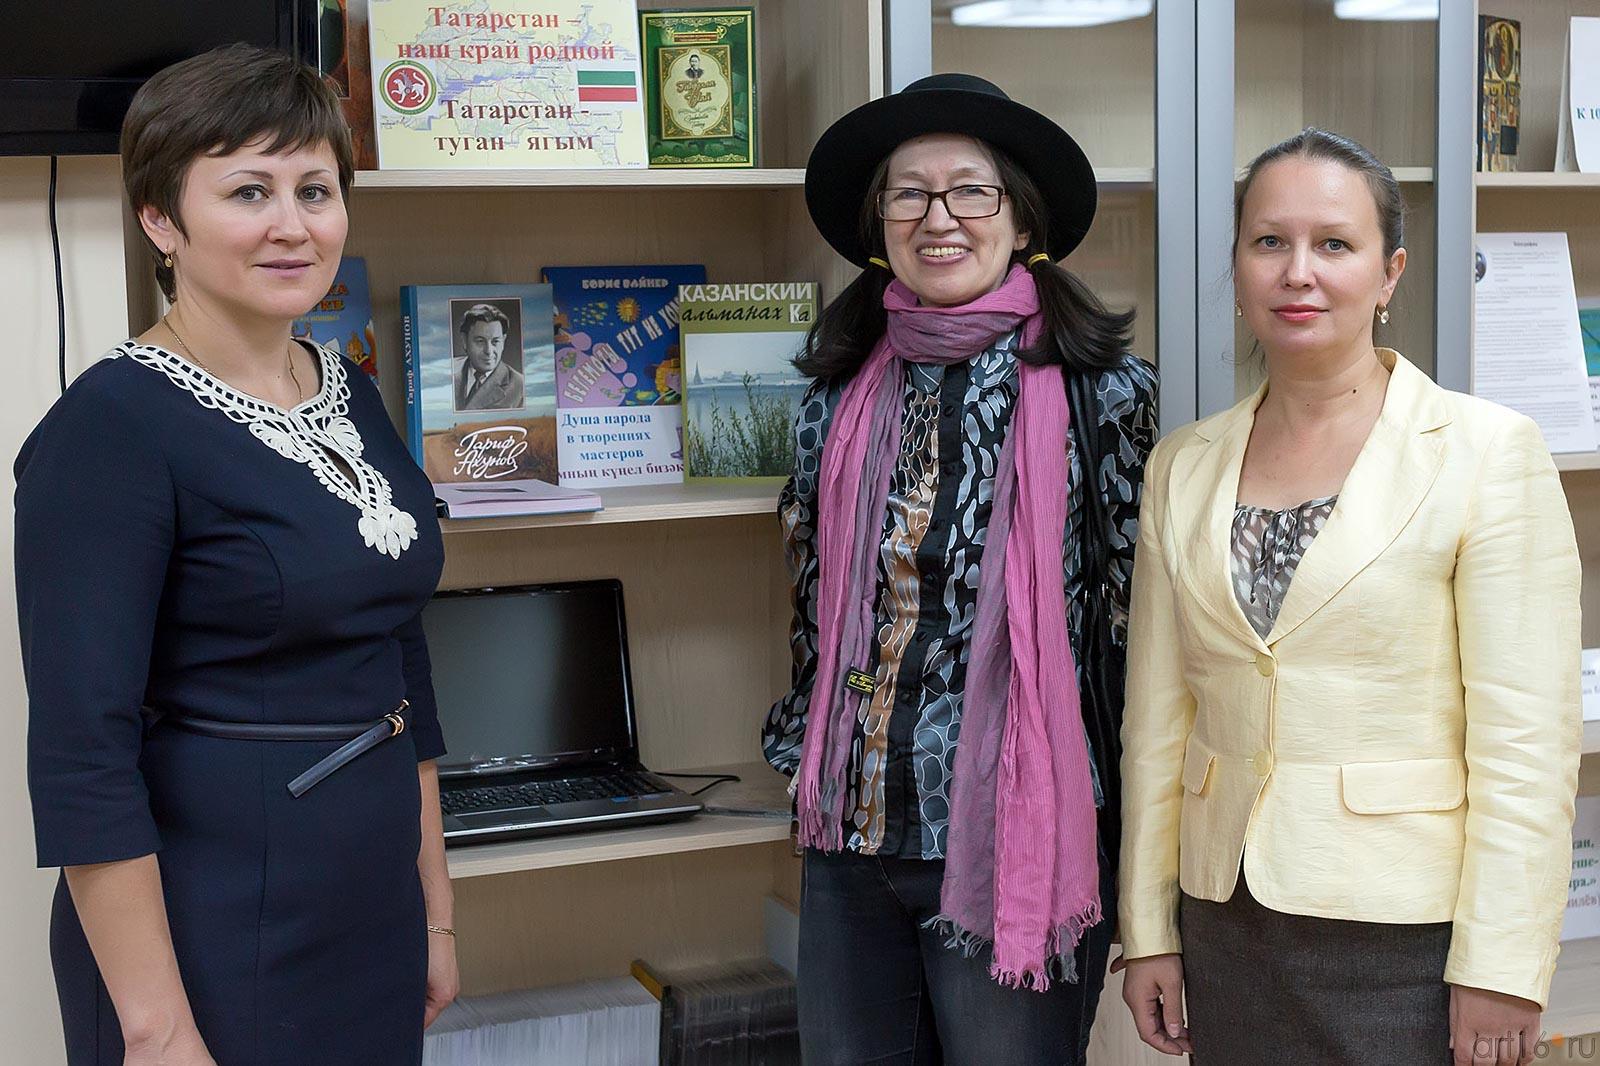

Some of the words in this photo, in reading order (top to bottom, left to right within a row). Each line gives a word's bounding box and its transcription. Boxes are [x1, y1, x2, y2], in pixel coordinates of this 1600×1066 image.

[428, 7, 559, 32] Татарстан
[398, 43, 450, 58] наш
[460, 40, 519, 64] край
[528, 40, 615, 65] родной
[441, 99, 572, 125] Татарстан
[434, 136, 504, 156] туган
[527, 136, 594, 150] ягым
[680, 282, 812, 302] КАЗАНСКИЙ
[682, 305, 783, 321] альманах
[564, 343, 621, 403] БЕГЕМОТЫ
[616, 325, 644, 355] ТУТ
[642, 315, 663, 341] НЕ
[561, 414, 600, 428] Душа
[604, 413, 651, 426] народа
[454, 425, 527, 457] Гариф
[567, 434, 575, 443] в
[579, 431, 651, 445] творениях
[453, 441, 528, 479] Ахунов
[580, 449, 644, 461] мастеров
